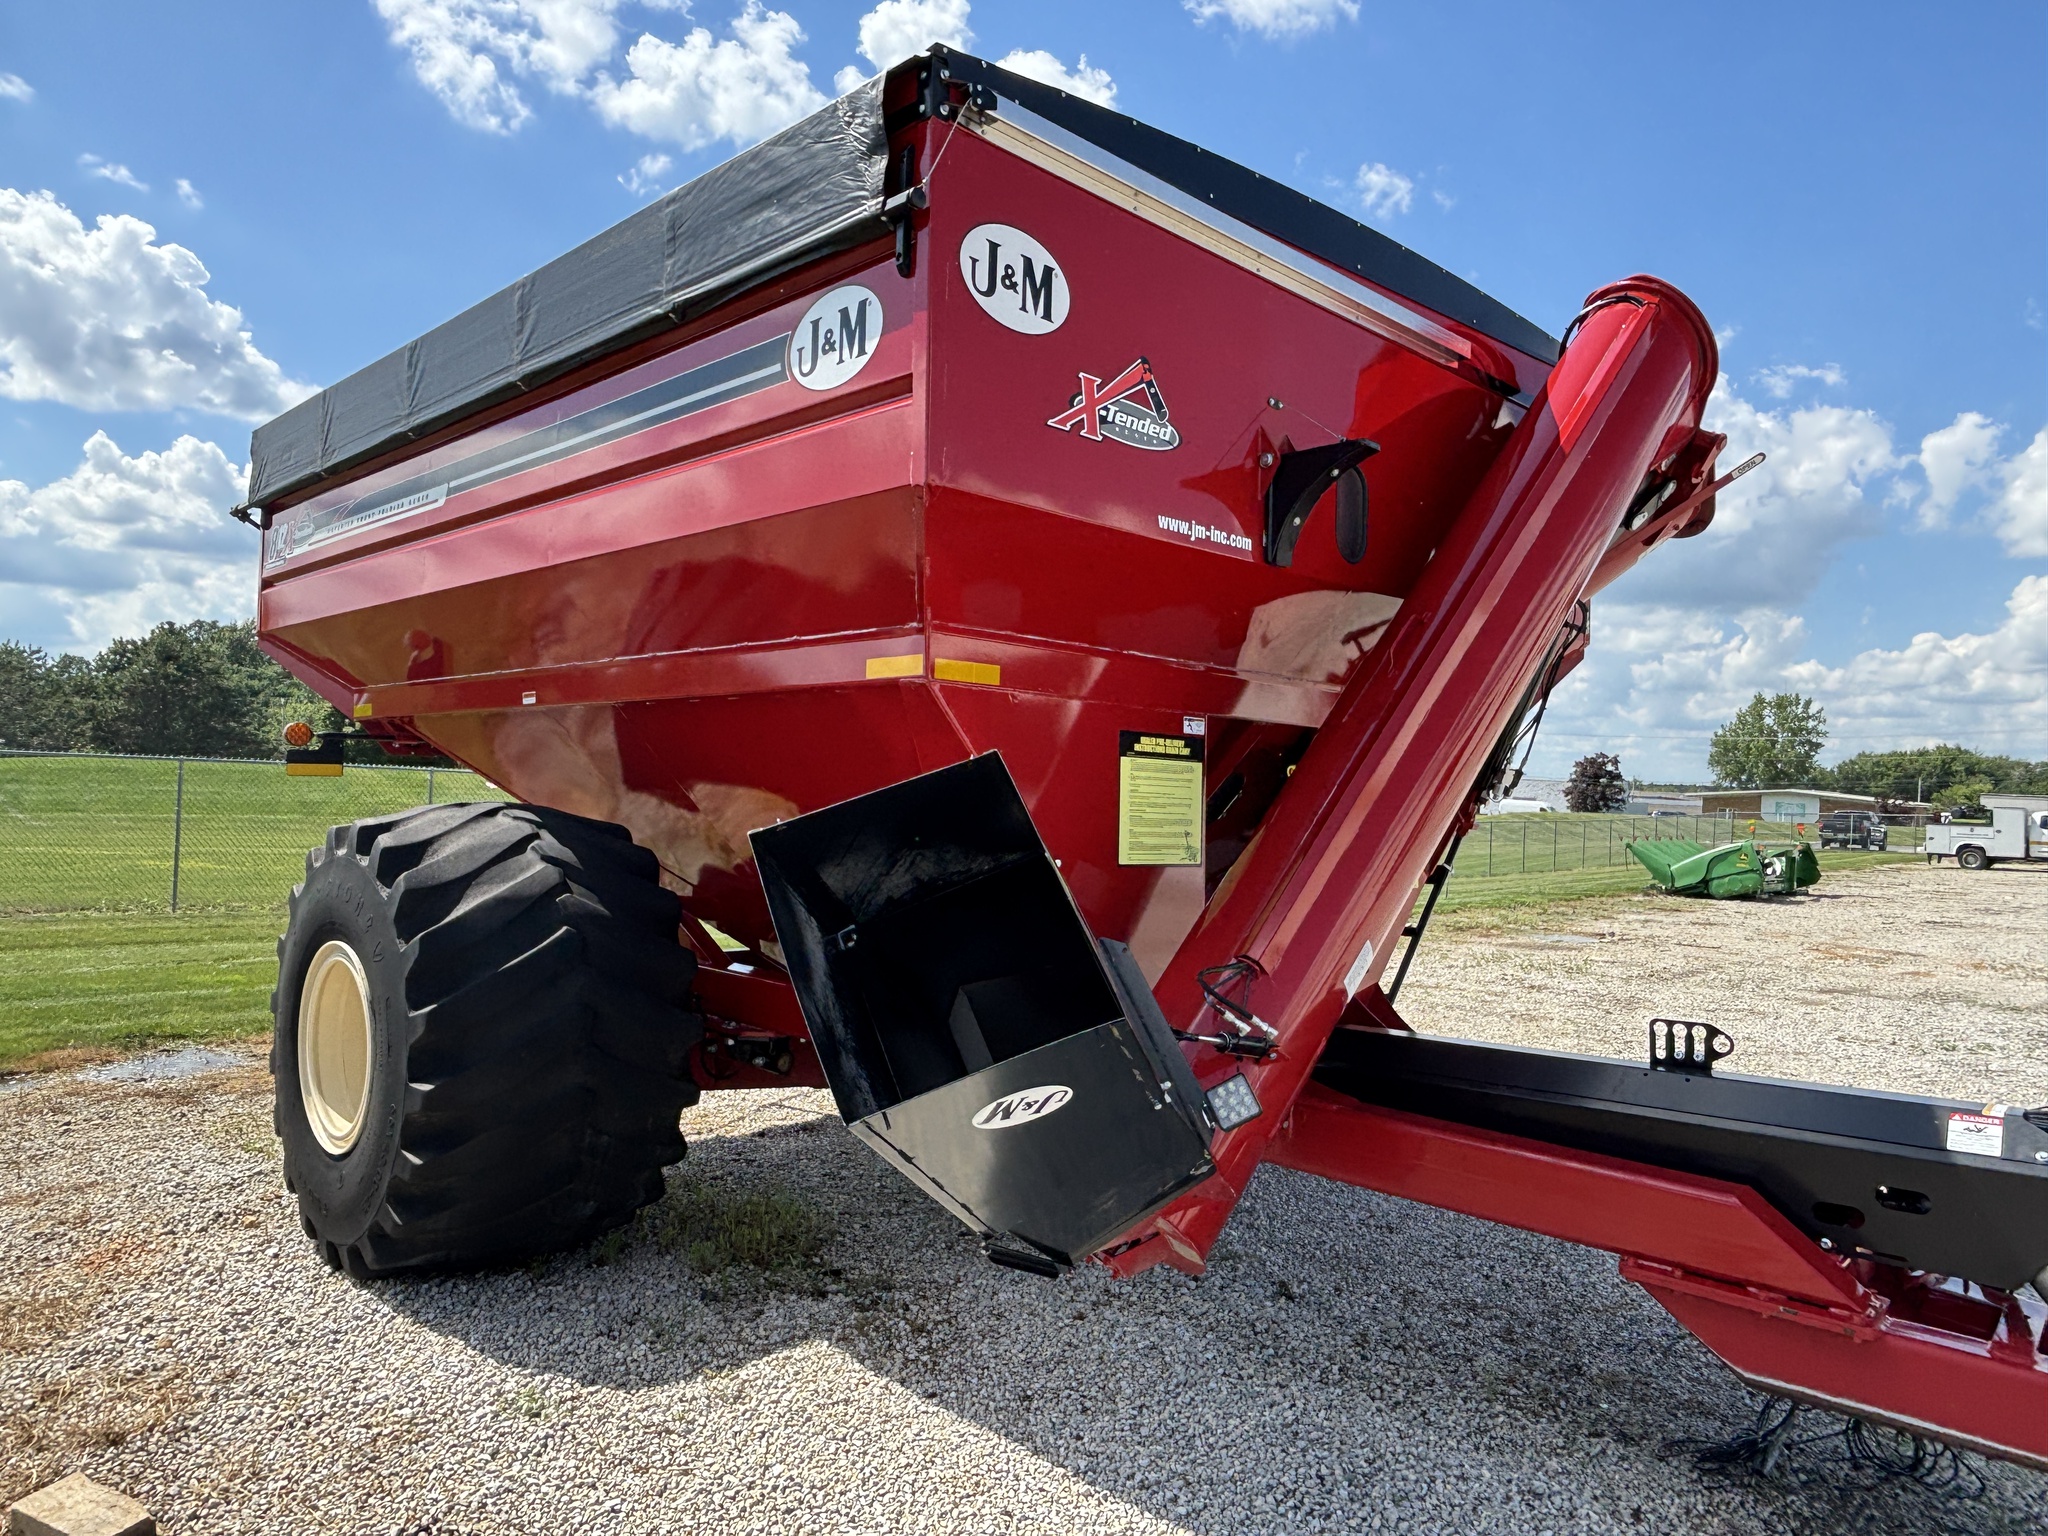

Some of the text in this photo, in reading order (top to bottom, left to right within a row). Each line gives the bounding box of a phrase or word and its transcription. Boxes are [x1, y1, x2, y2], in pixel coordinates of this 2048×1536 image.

[968, 238, 1056, 324] J&M
[796, 297, 870, 378] J&M
[1046, 357, 1173, 441] X-Tended
[1157, 514, 1253, 551] www.jm-inc.com
[976, 1089, 1070, 1126] J&M
[1962, 1114, 2001, 1125] DANGER
